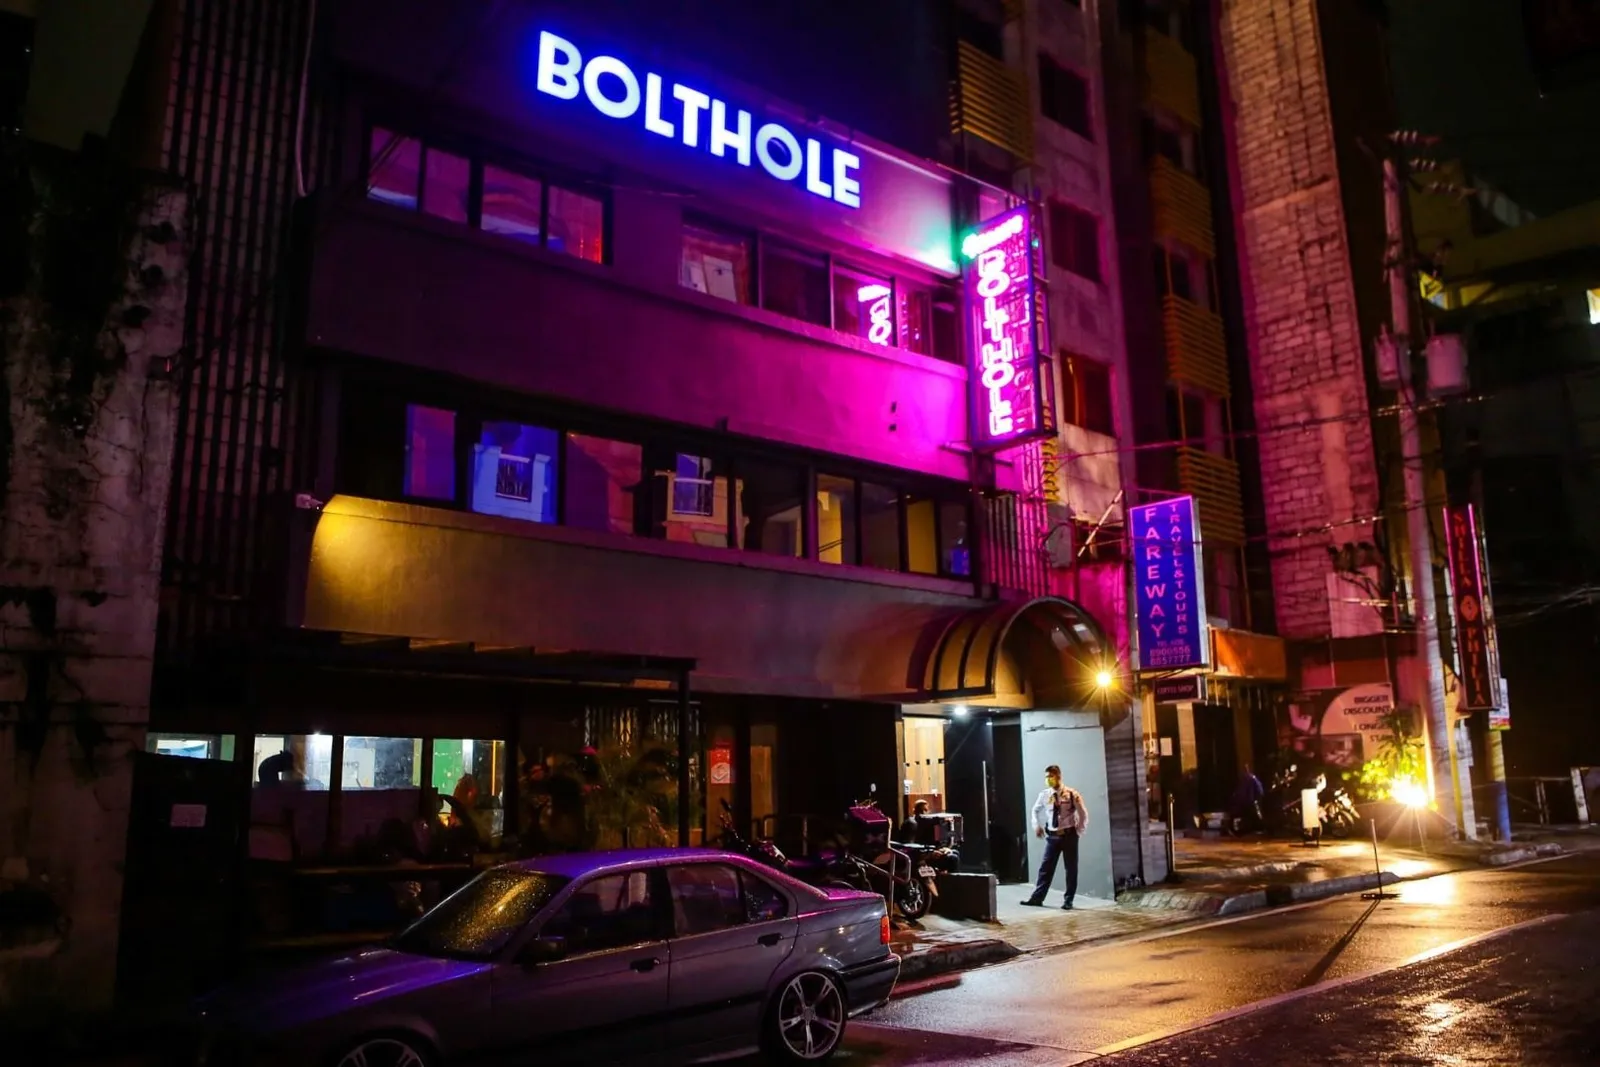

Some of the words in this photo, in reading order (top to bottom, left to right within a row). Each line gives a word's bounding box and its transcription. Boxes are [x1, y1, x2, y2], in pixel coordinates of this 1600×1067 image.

[537, 30, 861, 208] BOLTHOLE
[977, 249, 1015, 436] BOLTHOLE
[1144, 507, 1166, 638] FAREWAY
[1354, 695, 1389, 703] BIGGER
